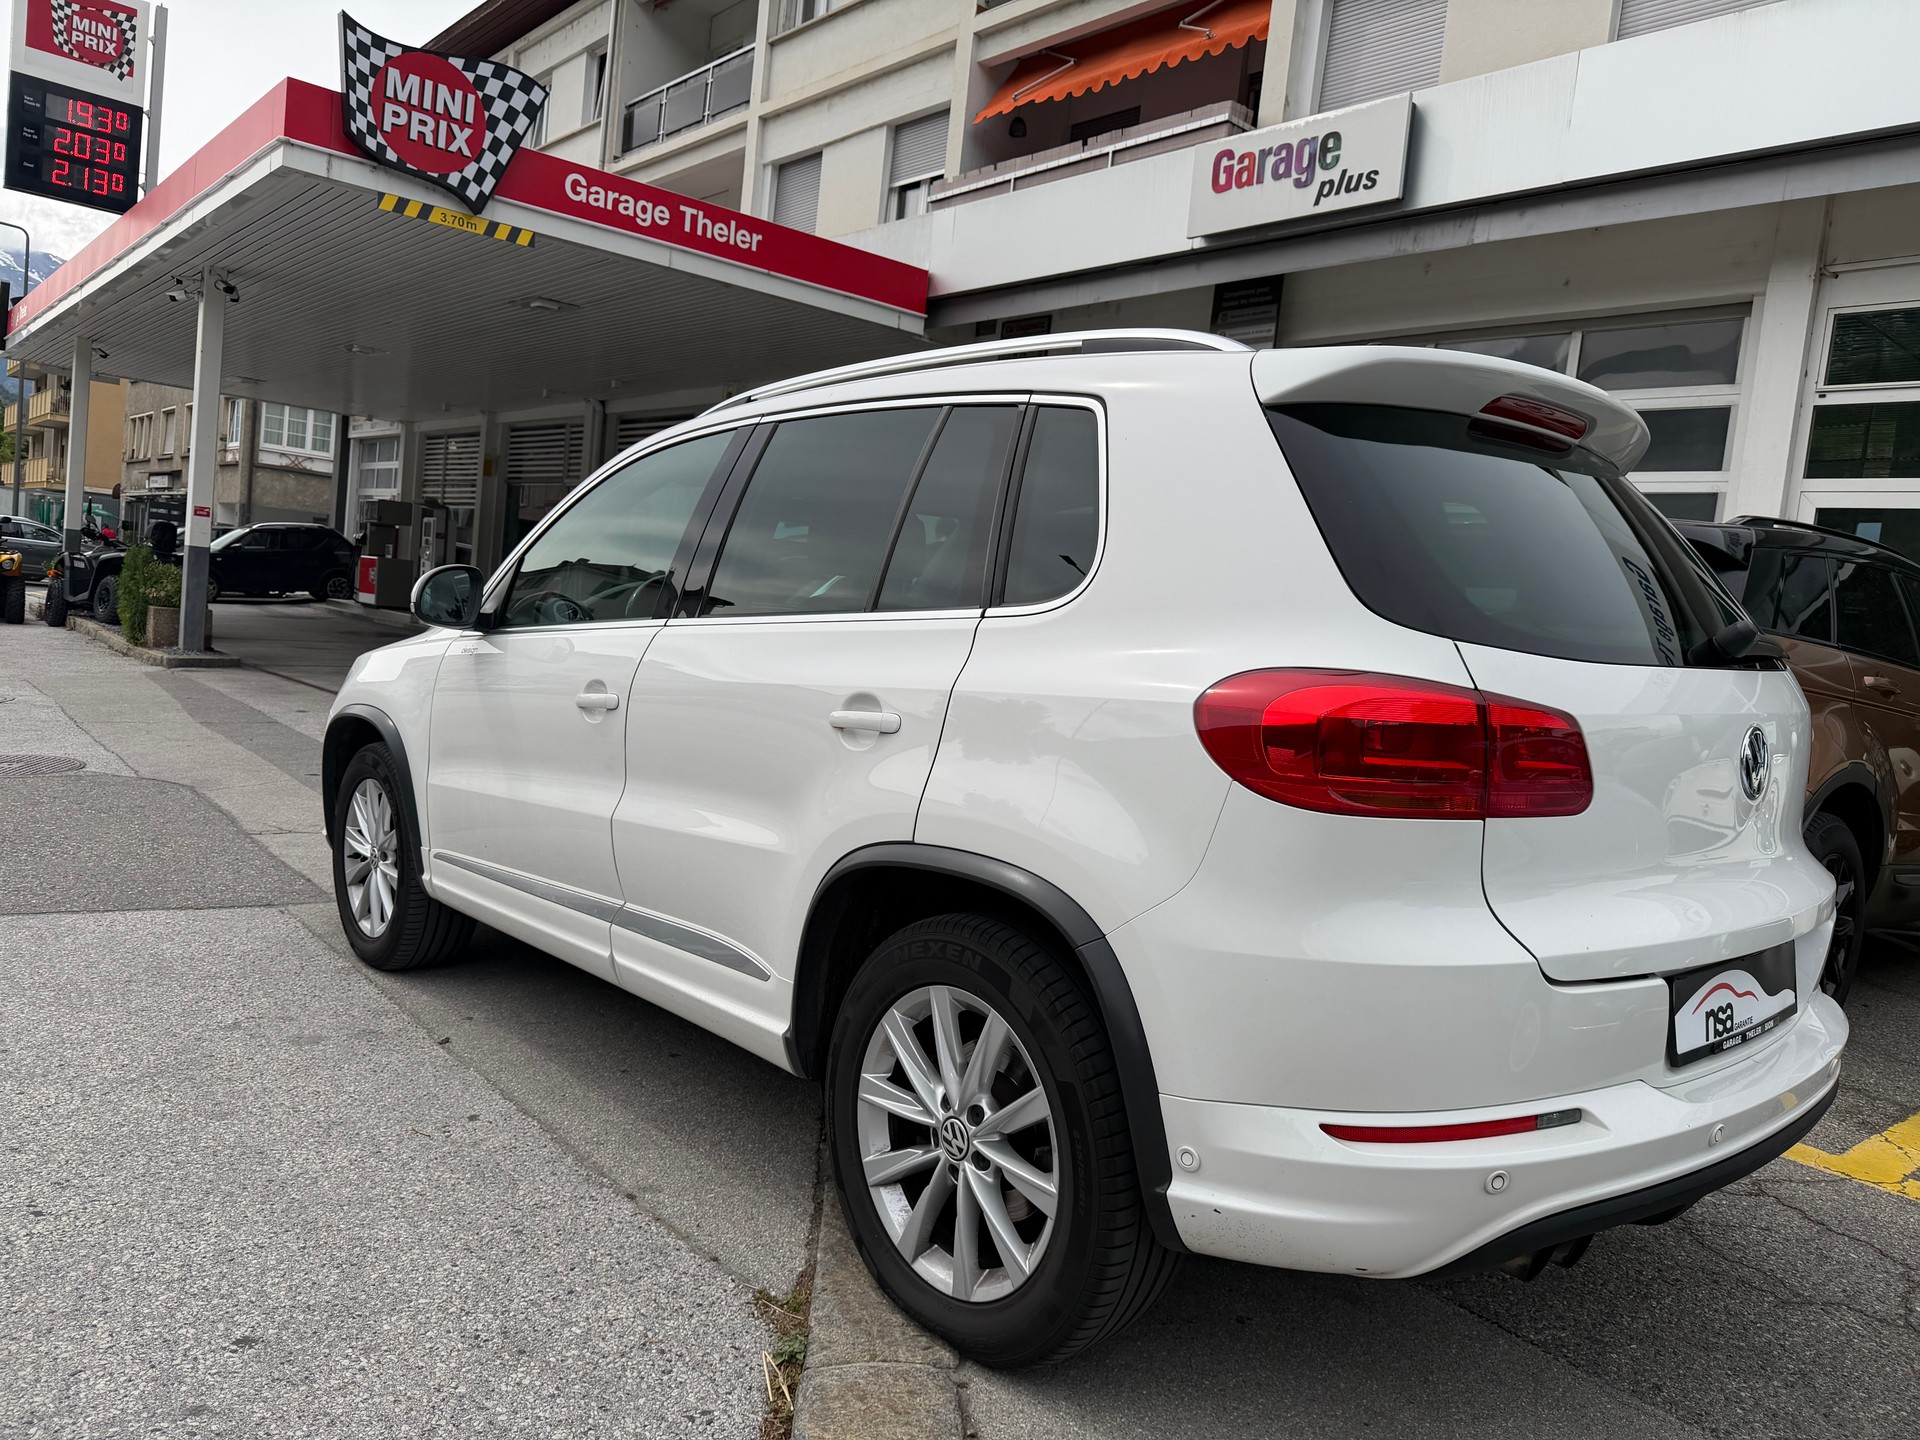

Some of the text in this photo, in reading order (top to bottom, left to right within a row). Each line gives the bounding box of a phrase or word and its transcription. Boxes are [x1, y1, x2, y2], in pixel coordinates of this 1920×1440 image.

[71, 30, 117, 57] PRIX
[72, 15, 118, 42] MINI
[385, 66, 476, 125] MINI
[382, 102, 474, 158] PRIX
[1211, 131, 1342, 194] Garage
[1313, 169, 1379, 207] plus
[564, 172, 763, 252] Garage Theler
[894, 941, 982, 971] NEXEN
[1705, 1002, 1734, 1042] nsa
[1722, 1020, 1774, 1050] GARAGE THELER SION
[1734, 1016, 1754, 1031] GARANTIE
